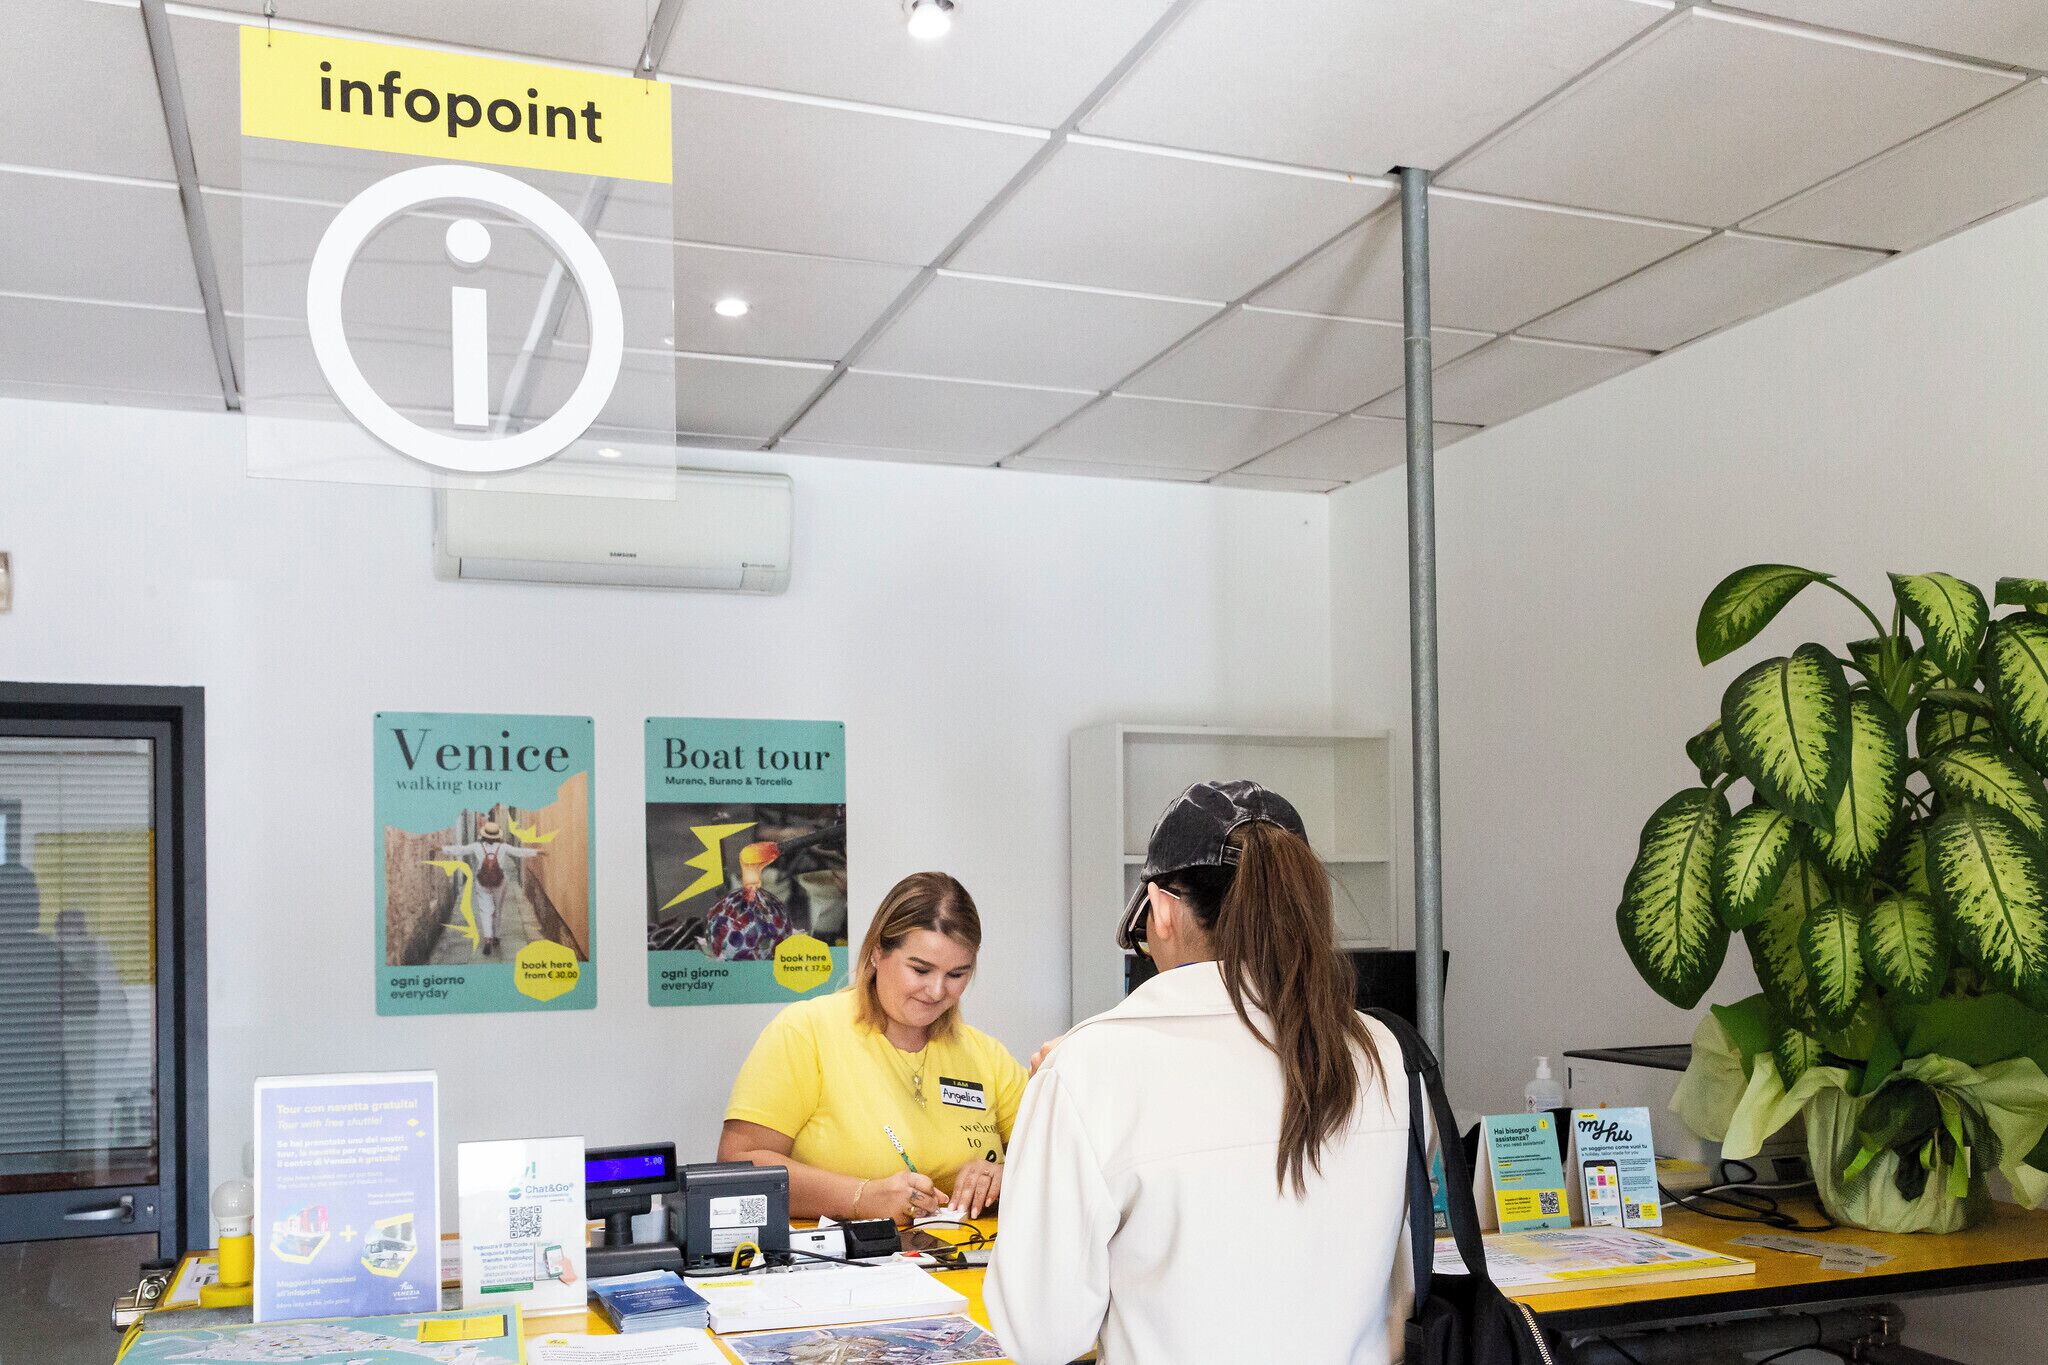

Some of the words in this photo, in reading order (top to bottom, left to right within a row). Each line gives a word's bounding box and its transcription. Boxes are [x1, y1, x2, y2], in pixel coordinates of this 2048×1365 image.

[319, 60, 603, 144] infopoint
[390, 728, 569, 772] Venice
[663, 737, 745, 769] Boat
[757, 746, 830, 770] tour
[395, 776, 463, 794] walking
[468, 779, 501, 791] tour
[665, 776, 707, 786] Murano,
[709, 777, 743, 786] Burano
[744, 777, 752, 786] &
[754, 777, 793, 786] Torcello
[522, 961, 547, 969] book
[550, 960, 573, 969] here
[780, 954, 804, 963] book
[806, 954, 827, 962] here
[661, 968, 688, 980] ogni
[691, 967, 729, 979] giorno
[390, 976, 420, 988] ogni
[423, 975, 465, 987] giorno
[661, 979, 714, 991] everyday
[390, 988, 448, 1000] everyday
[943, 1088, 982, 1104] Angelica
[277, 1104, 300, 1114] Tour
[304, 1104, 325, 1113] con
[328, 1102, 369, 1112] navetta
[278, 1120, 298, 1129] Tour
[1505, 1126, 1529, 1135] bisogno
[1530, 1125, 1537, 1133] di
[967, 1137, 982, 1148] to
[1495, 1134, 1529, 1143] assistenza?
